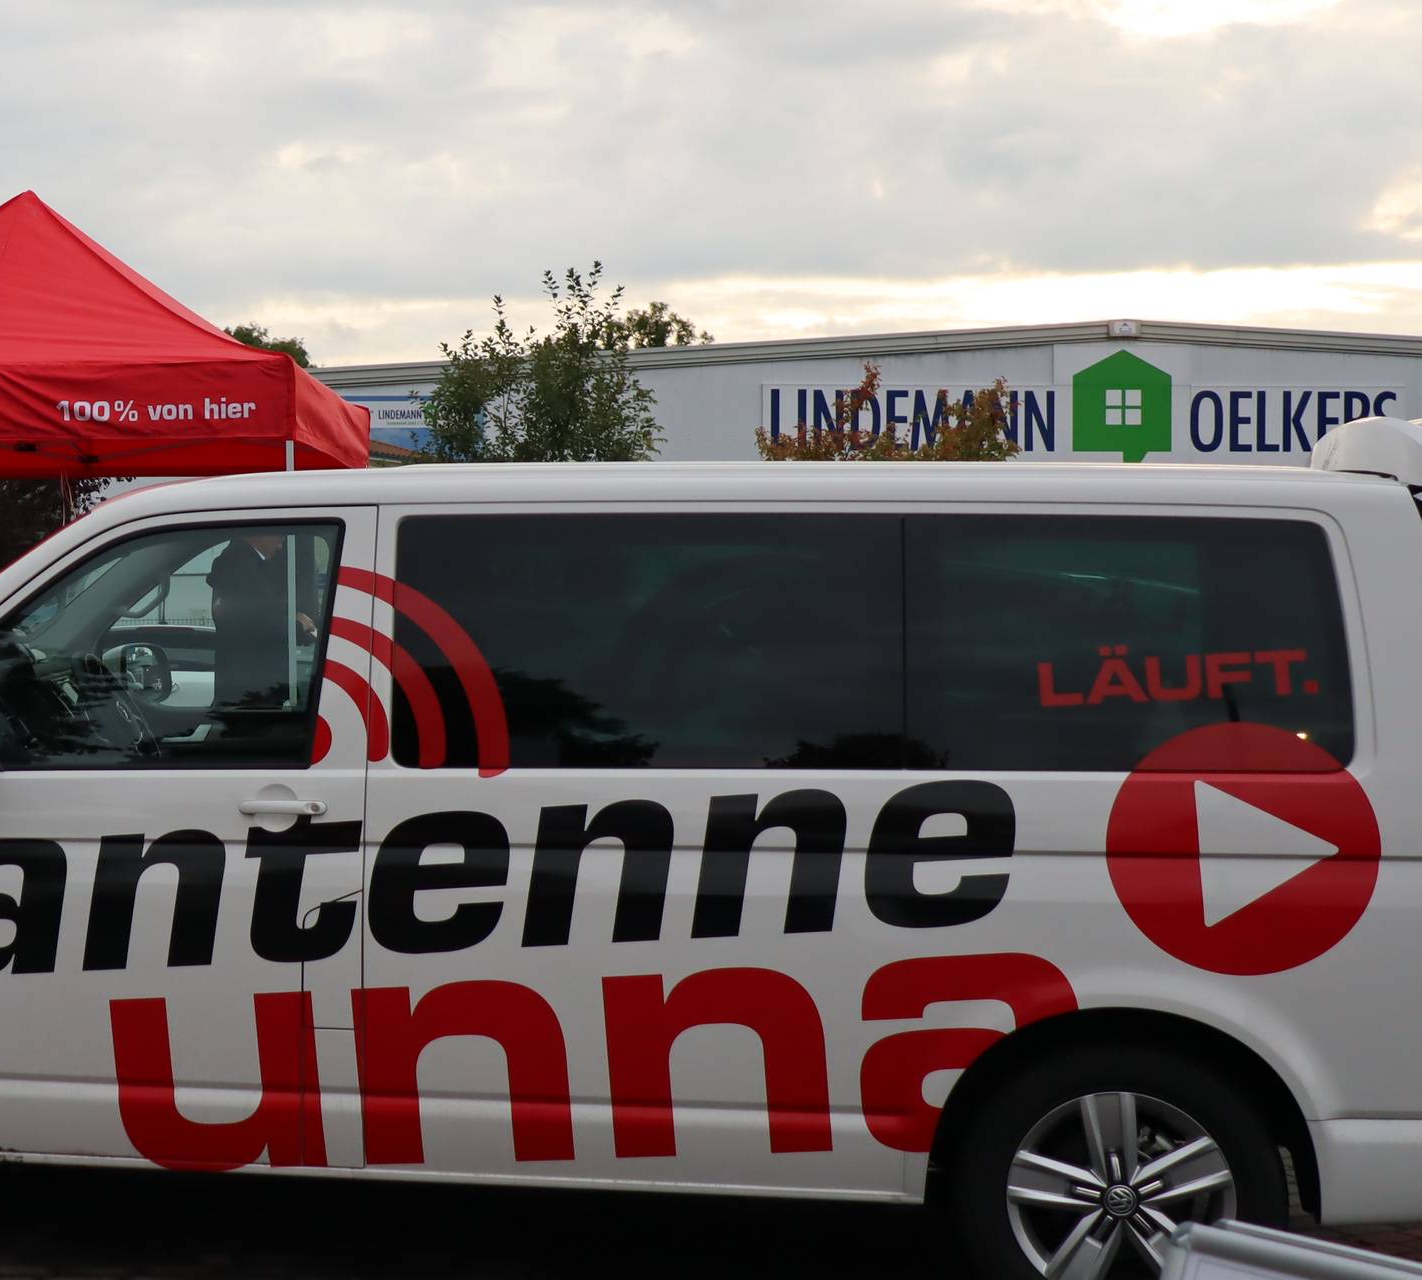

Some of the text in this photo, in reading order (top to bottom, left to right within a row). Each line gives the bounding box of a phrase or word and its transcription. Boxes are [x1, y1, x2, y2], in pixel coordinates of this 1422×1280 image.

[57, 397, 256, 422] 100% von hier
[378, 409, 422, 420] LINDEMANN
[1037, 645, 1320, 707] LÄUFT.
[109, 952, 1080, 1172] unna
